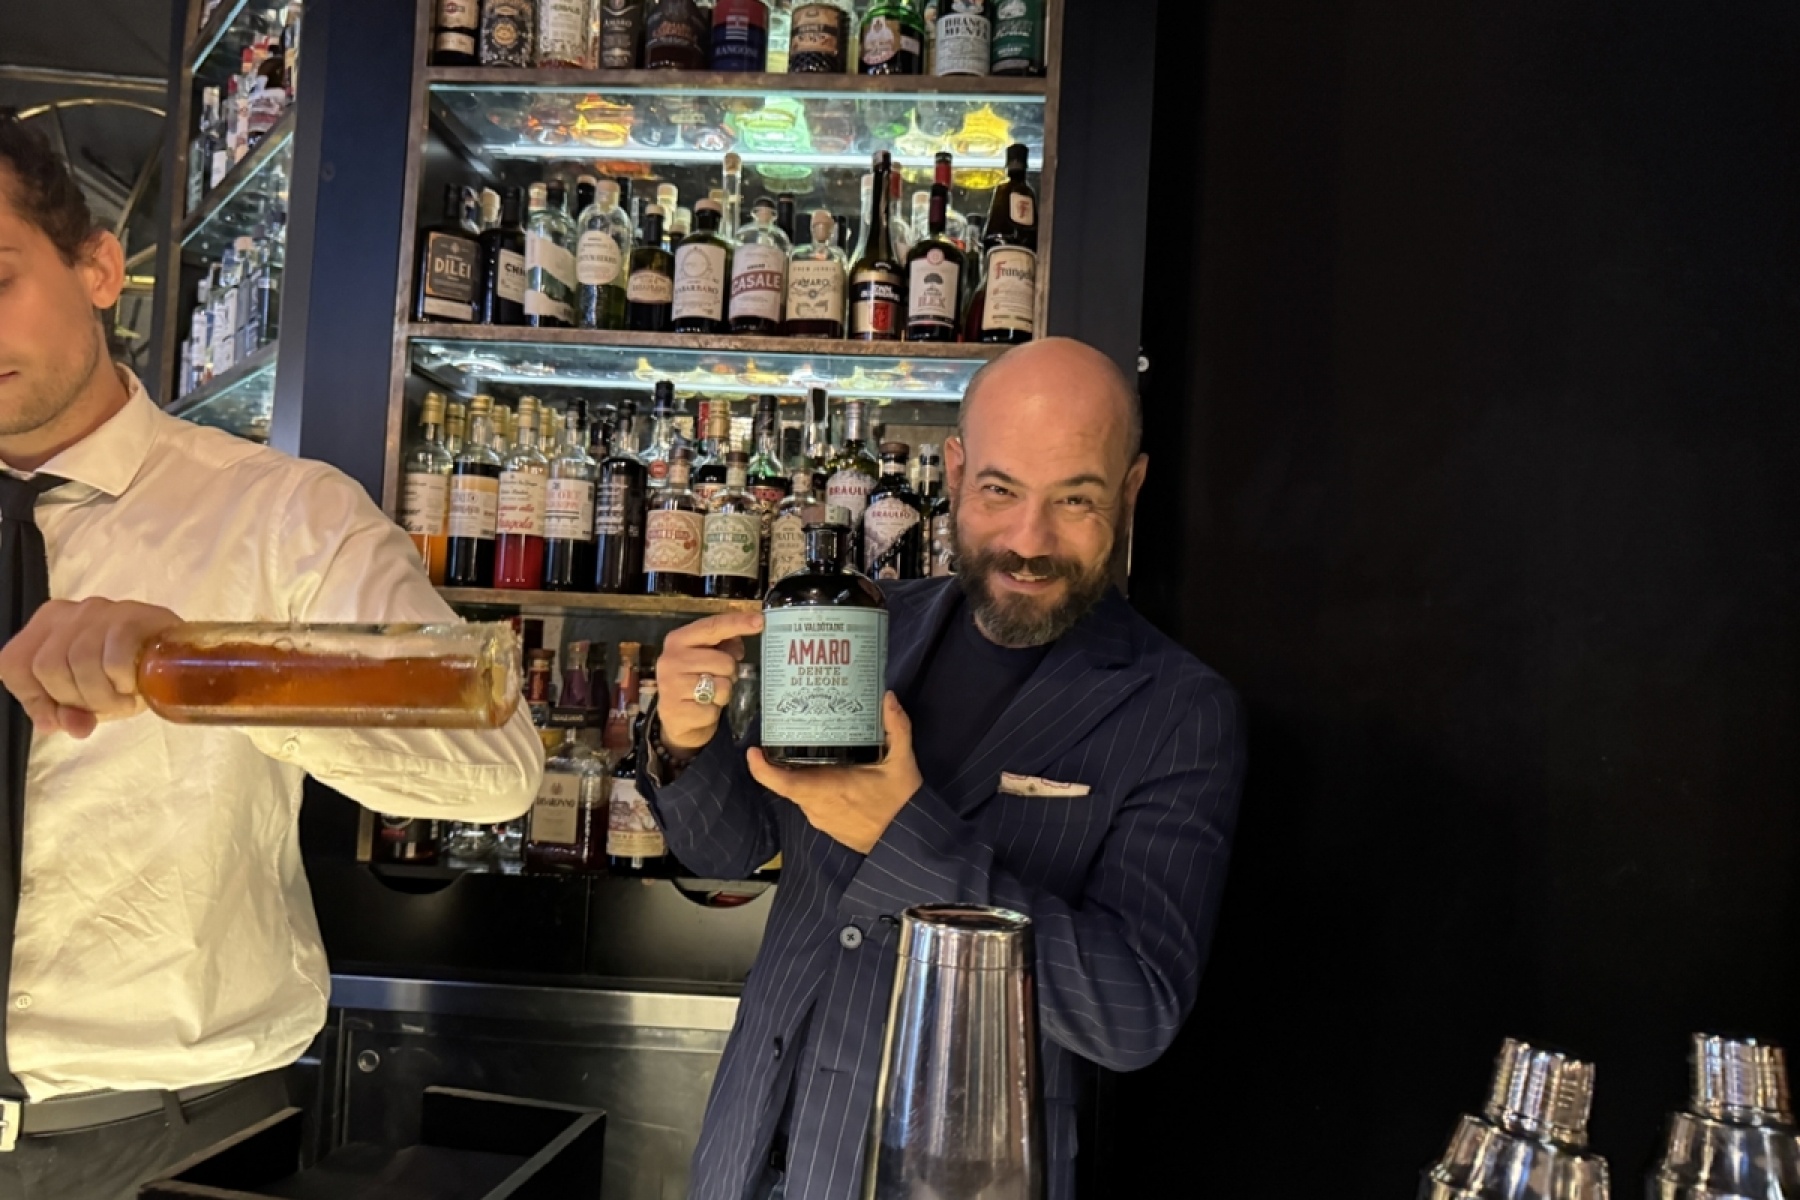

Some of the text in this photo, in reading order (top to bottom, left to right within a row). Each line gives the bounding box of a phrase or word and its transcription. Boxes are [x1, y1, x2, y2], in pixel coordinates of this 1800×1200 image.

[794, 623, 802, 633] LA
[787, 638, 851, 666] AMARO
[797, 666, 841, 676] DENTE
[791, 677, 849, 687] DI LEONE
